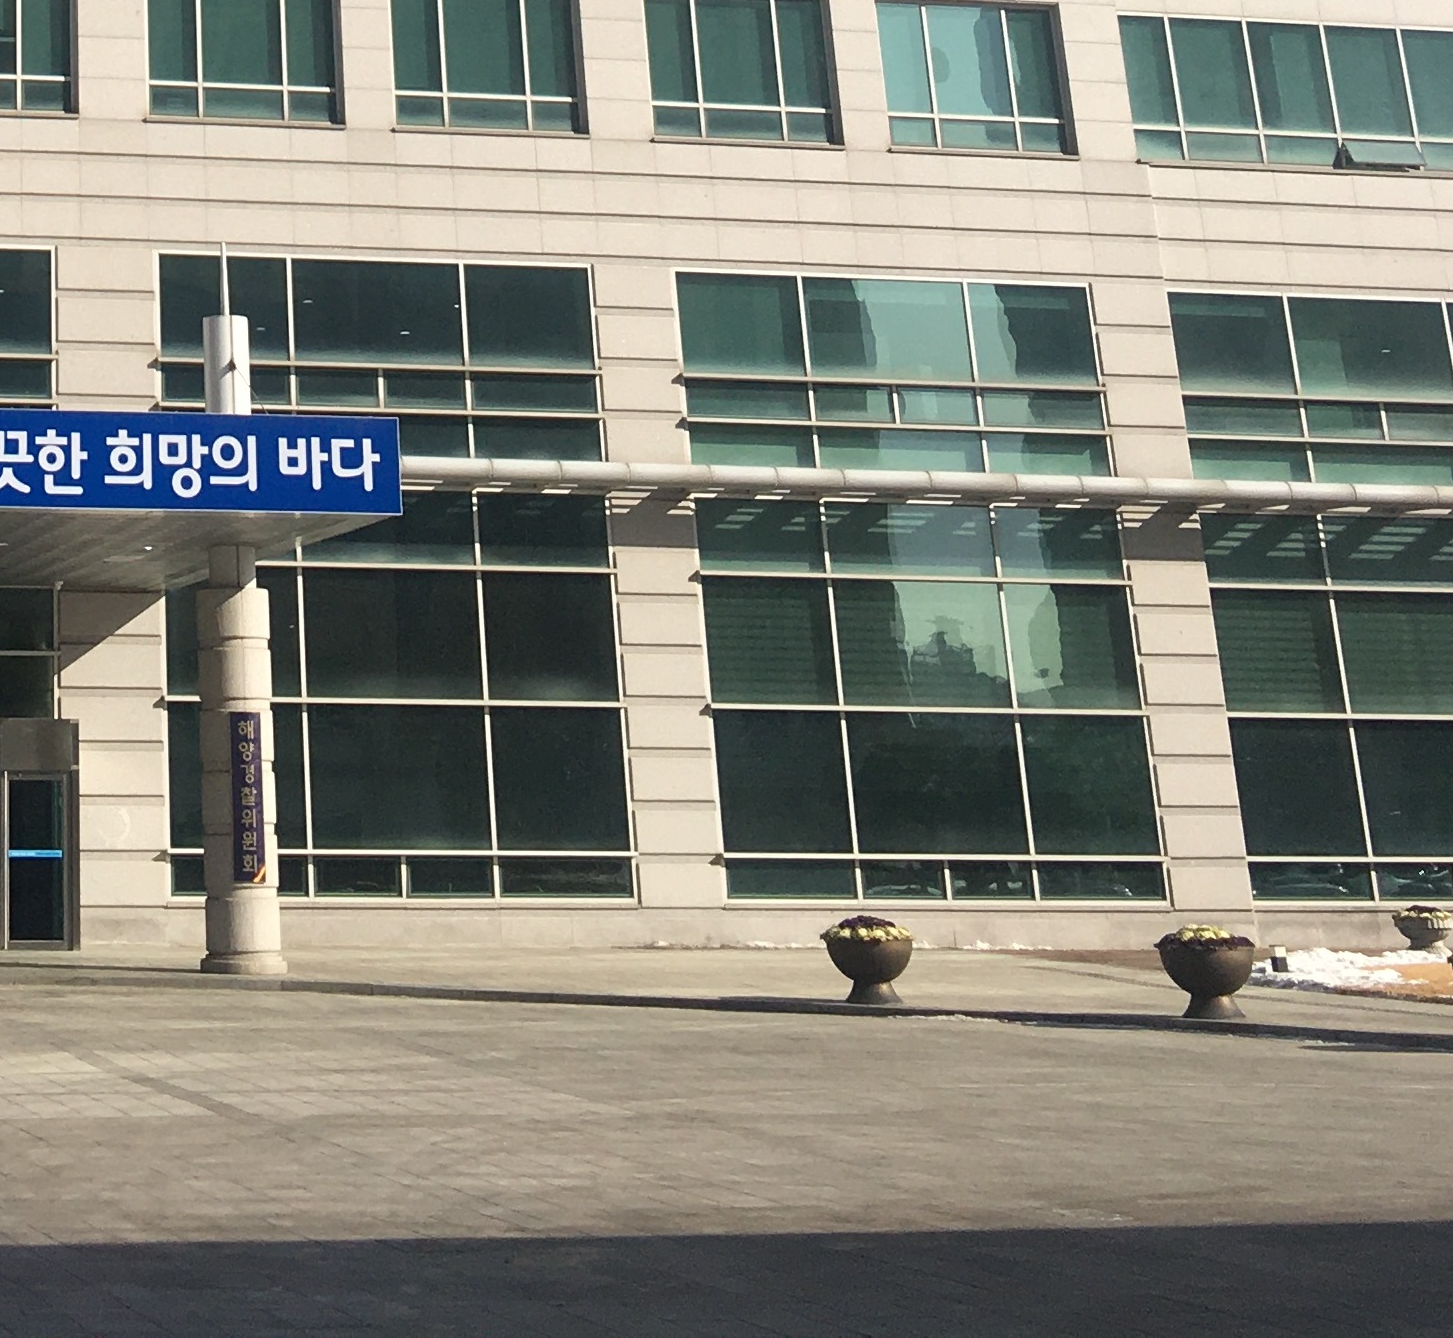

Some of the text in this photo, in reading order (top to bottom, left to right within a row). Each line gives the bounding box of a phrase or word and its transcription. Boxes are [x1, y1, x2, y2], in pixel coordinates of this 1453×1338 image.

[104, 429, 260, 498] 희망의
[277, 435, 381, 493] 바다
[237, 720, 258, 873] 해양경찰위원회
